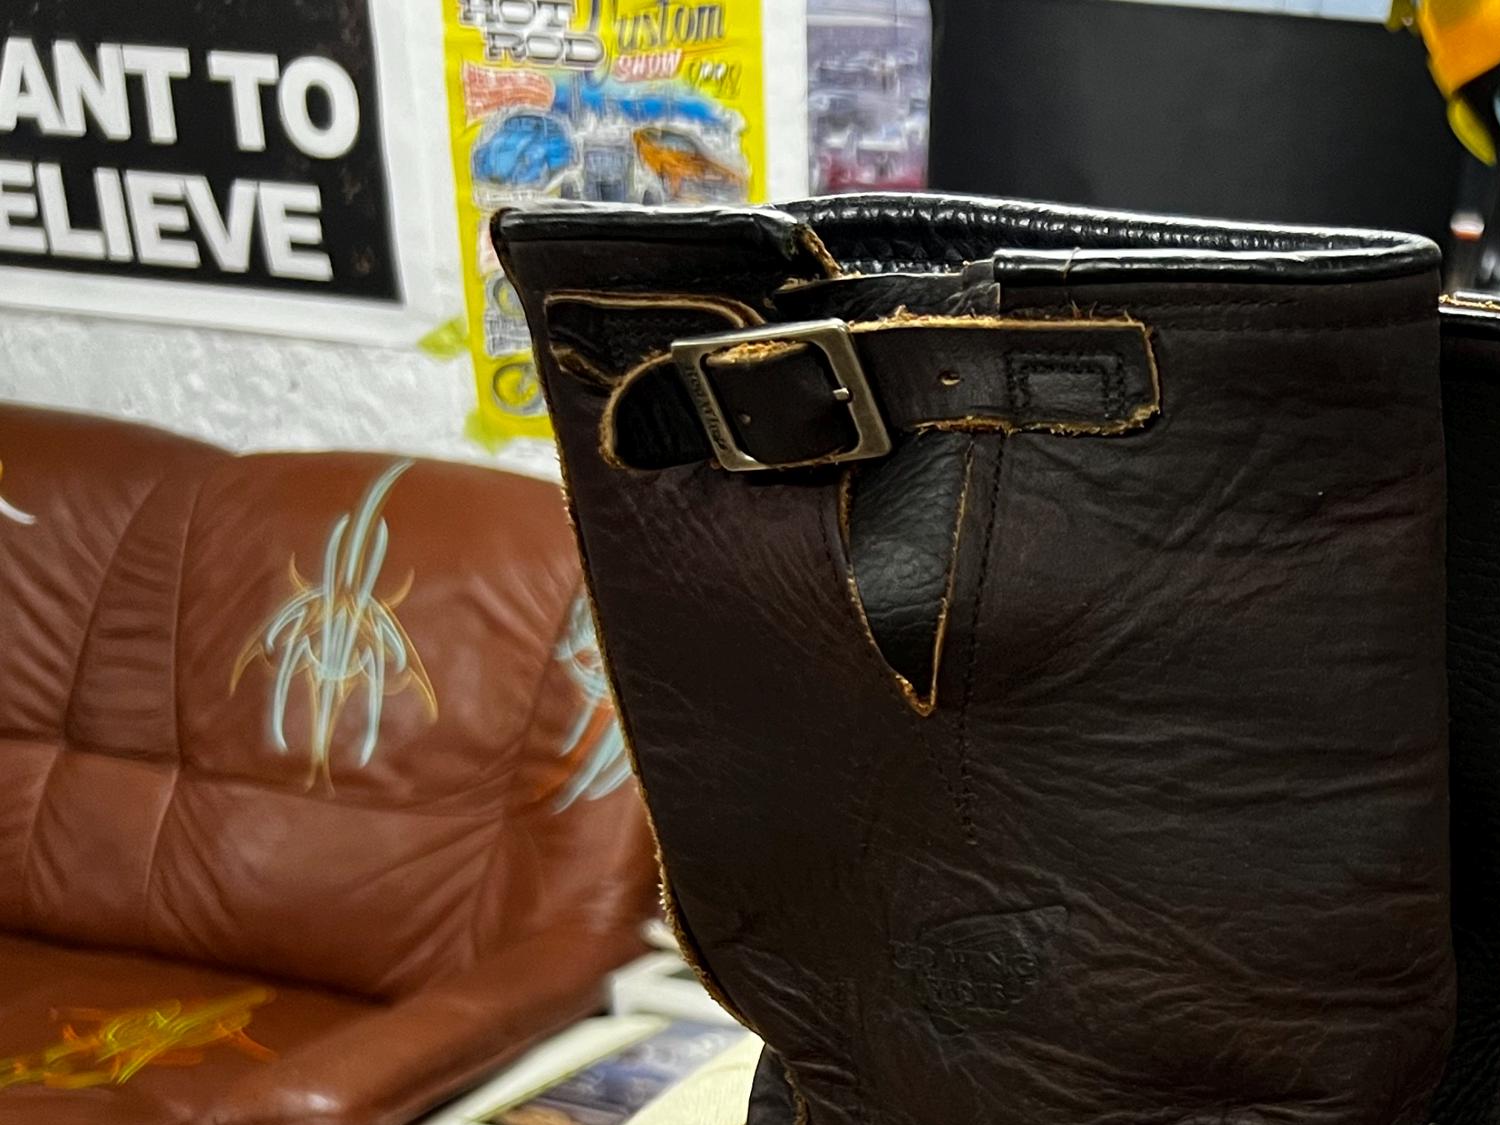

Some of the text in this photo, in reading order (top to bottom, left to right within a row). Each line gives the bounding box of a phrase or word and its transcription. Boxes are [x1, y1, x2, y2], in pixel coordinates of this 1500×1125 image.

[486, 30, 606, 69] ROD
[613, 50, 682, 81] SHOW
[206, 49, 361, 160] TO
